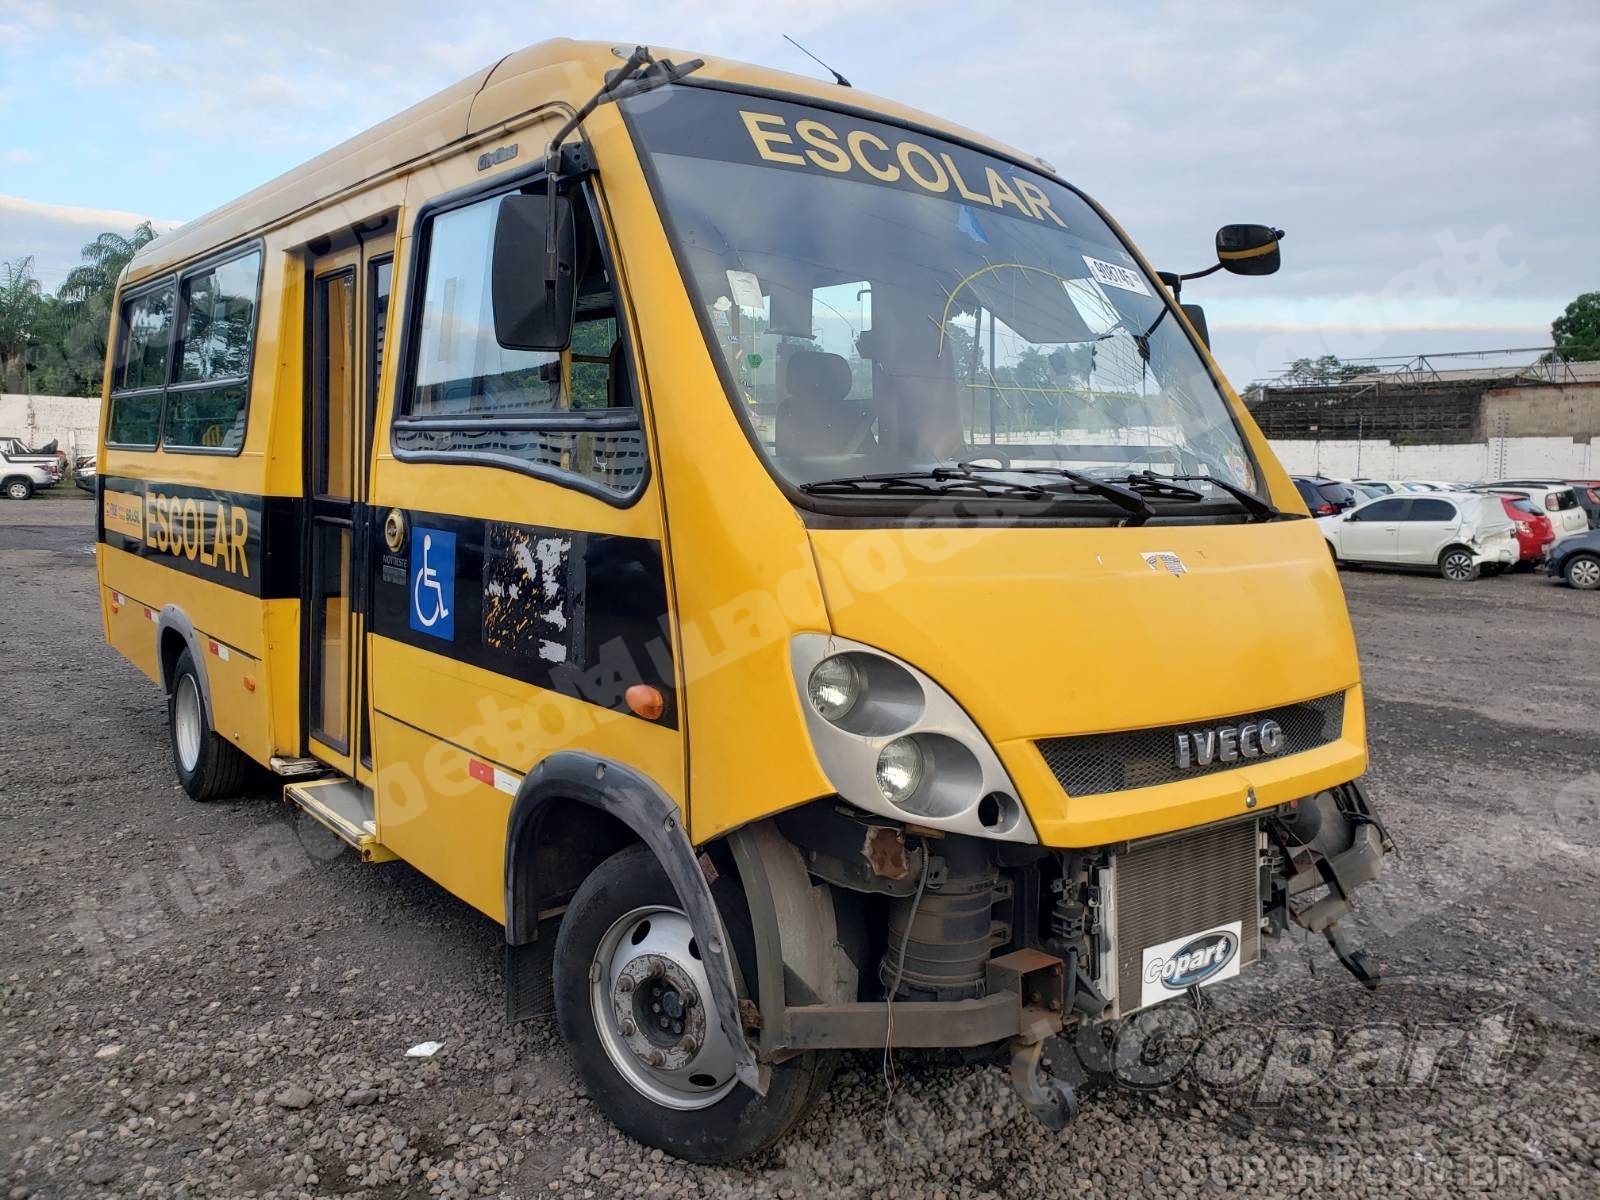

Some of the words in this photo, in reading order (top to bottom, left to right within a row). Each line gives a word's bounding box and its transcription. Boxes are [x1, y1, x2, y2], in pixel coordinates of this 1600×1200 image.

[738, 109, 1068, 229] ESCOLAR
[145, 491, 249, 578] ESCOLAR
[1177, 719, 1283, 769] IVECO
[1143, 936, 1229, 985] Copart
